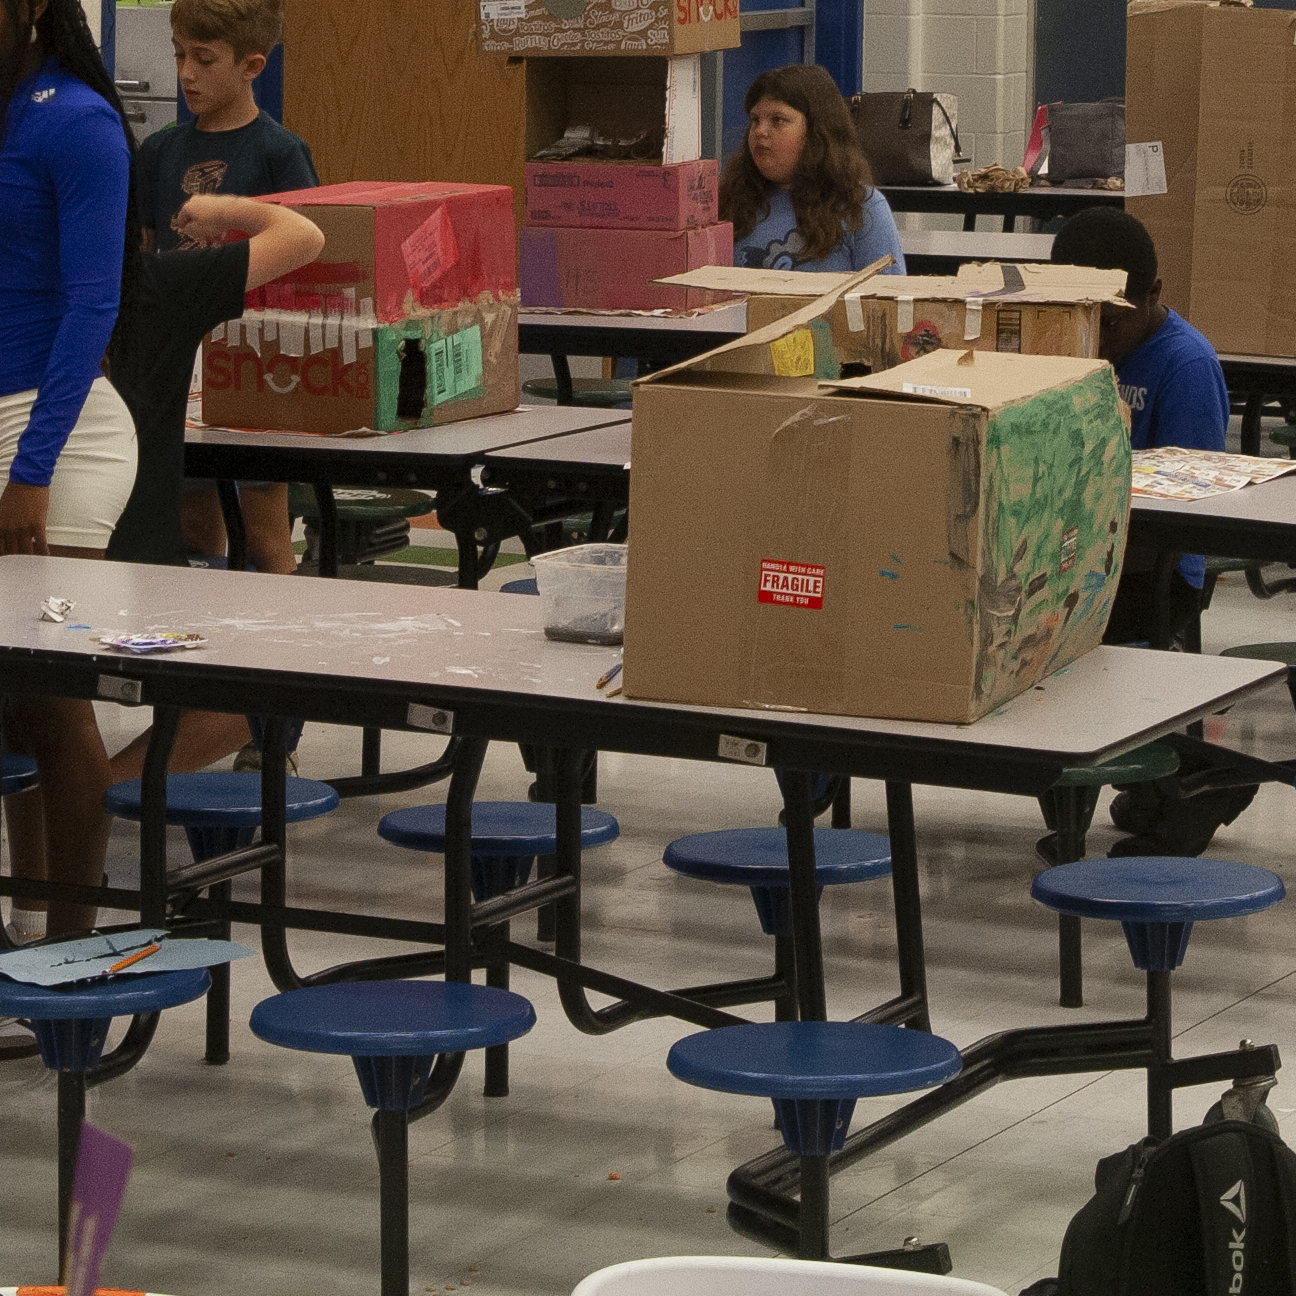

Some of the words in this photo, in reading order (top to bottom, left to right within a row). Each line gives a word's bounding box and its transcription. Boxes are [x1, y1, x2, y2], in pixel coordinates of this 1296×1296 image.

[789, 565, 806, 574] WITH
[807, 567, 825, 576] CARE
[763, 573, 822, 594] FRAGILE
[773, 593, 794, 603] THANK
[796, 596, 809, 605] YOU
